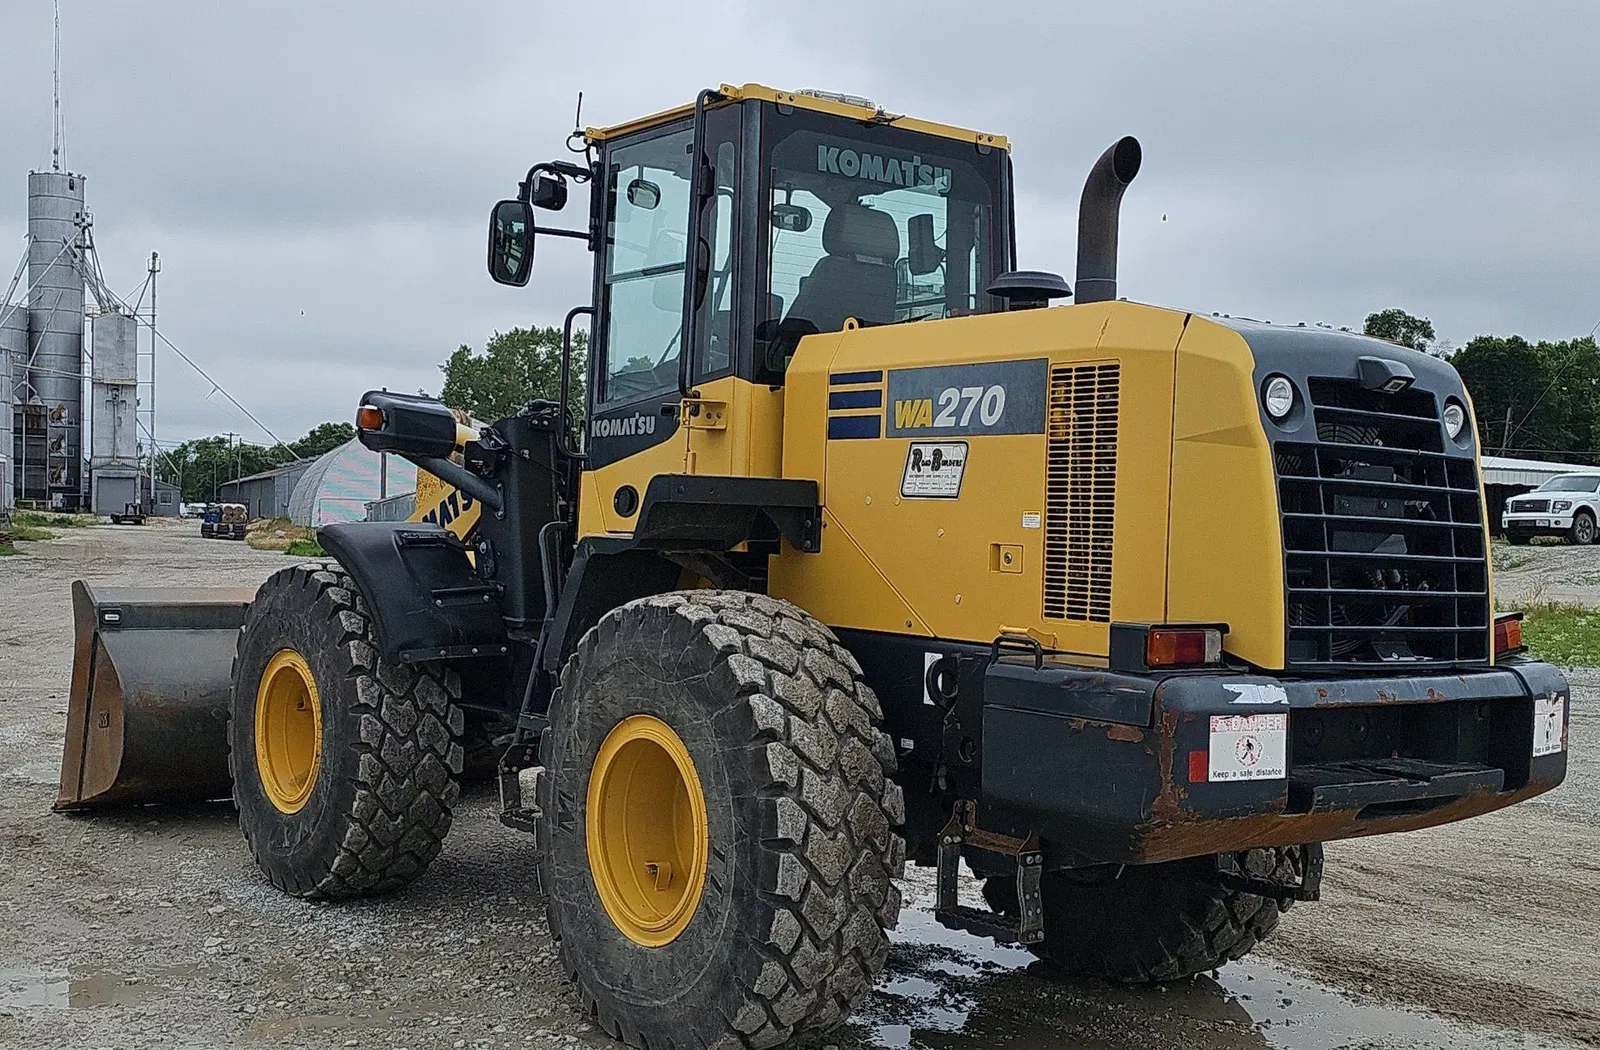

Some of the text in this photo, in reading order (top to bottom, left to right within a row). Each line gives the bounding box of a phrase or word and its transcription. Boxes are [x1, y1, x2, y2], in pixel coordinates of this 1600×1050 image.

[817, 144, 952, 193] KOMATSU
[895, 385, 1006, 429] WA270
[591, 412, 656, 438] KOMATSU
[1212, 770, 1229, 779] Keep
[1240, 769, 1253, 778] safe
[1256, 768, 1282, 777] distance
